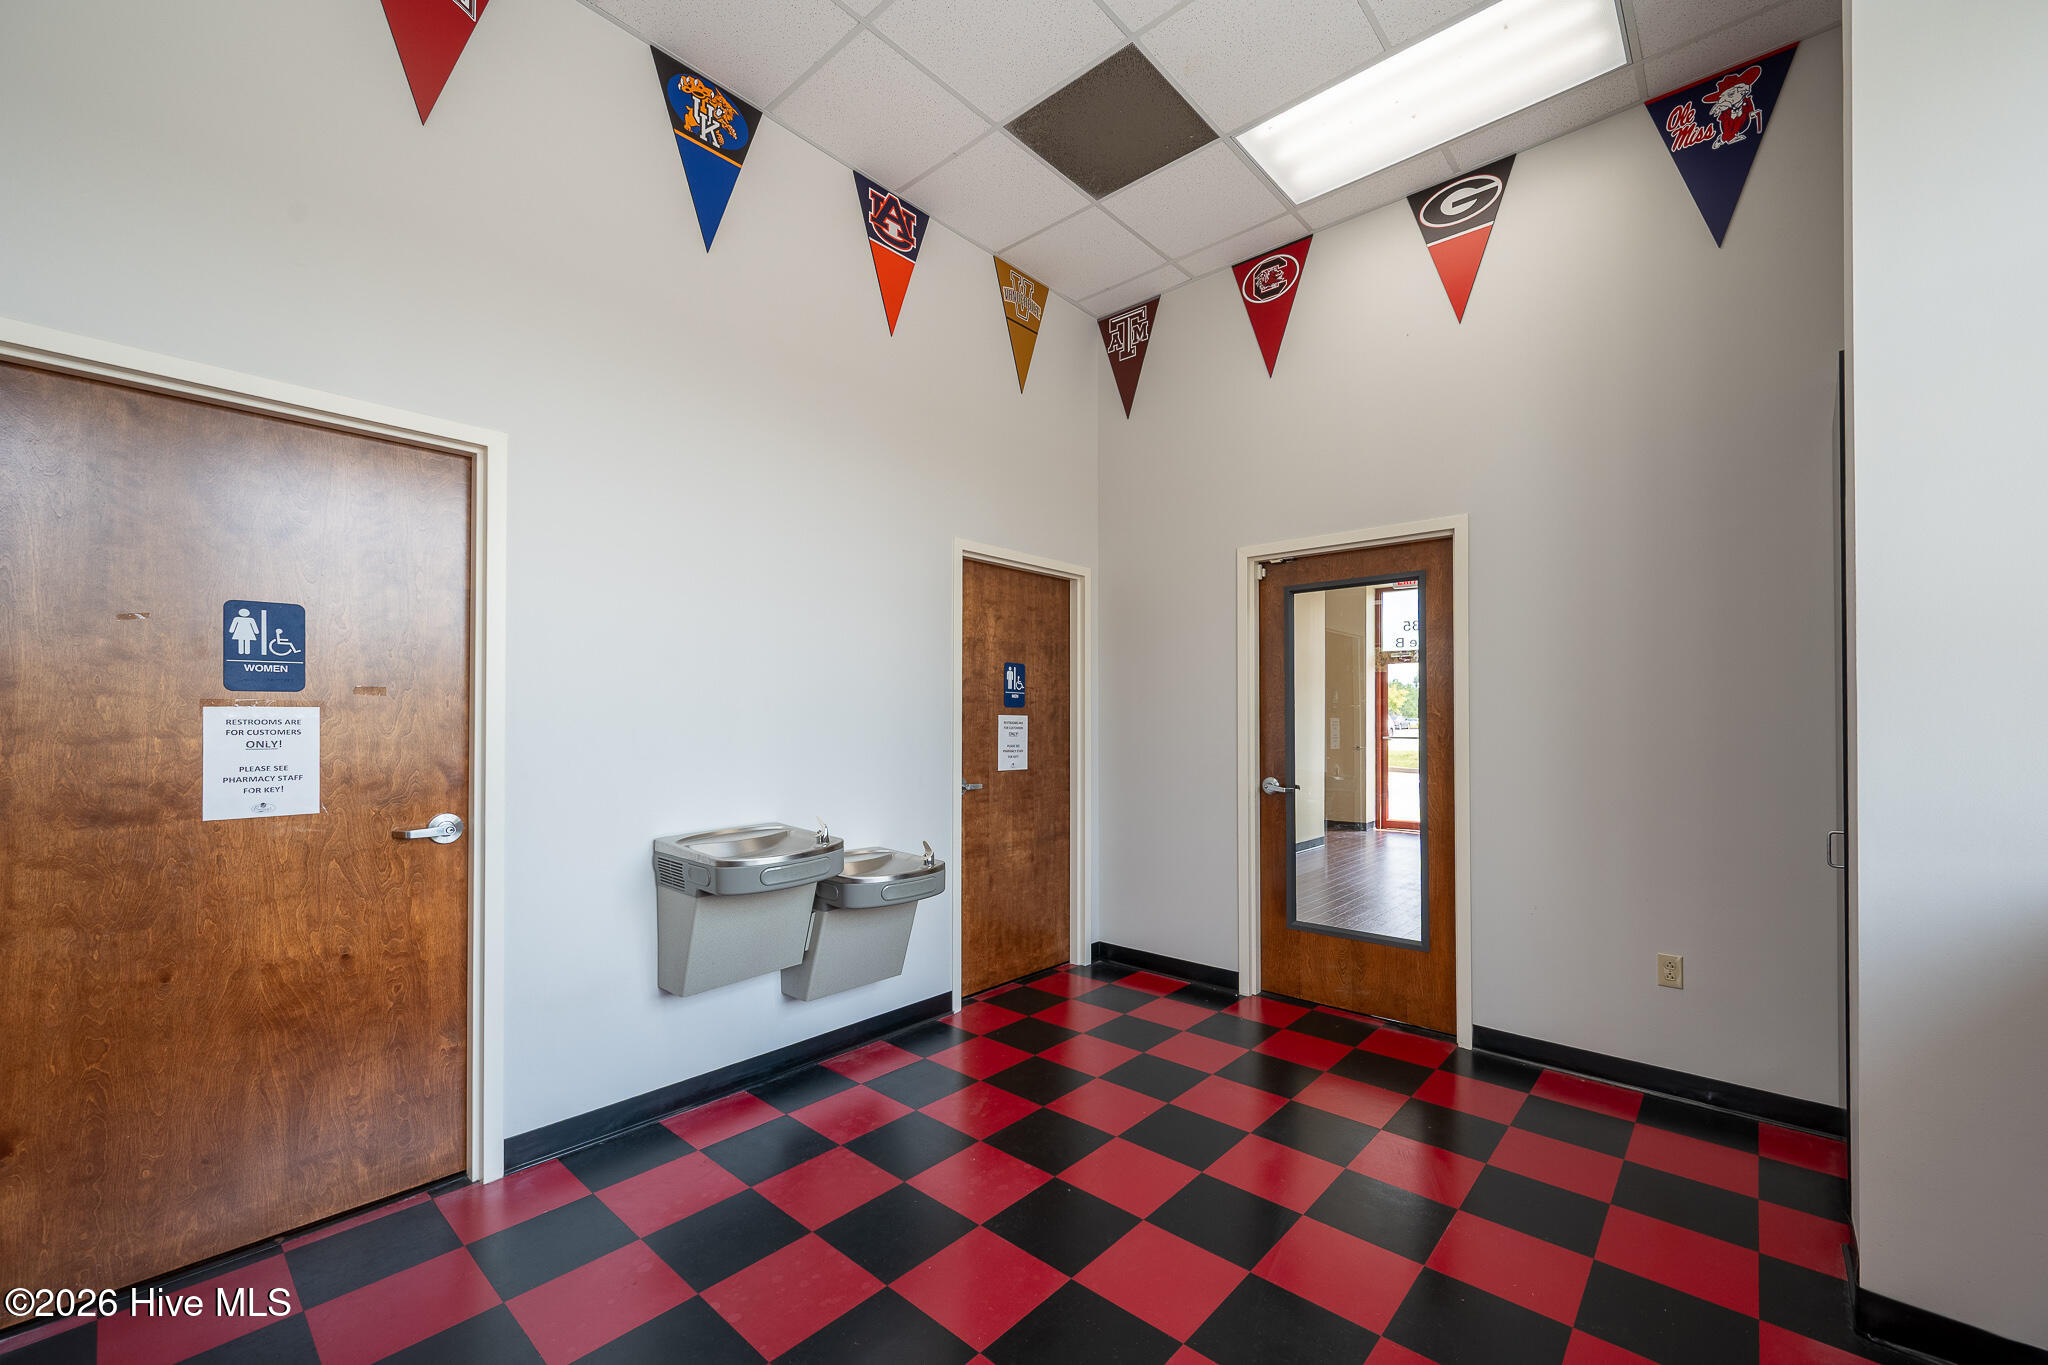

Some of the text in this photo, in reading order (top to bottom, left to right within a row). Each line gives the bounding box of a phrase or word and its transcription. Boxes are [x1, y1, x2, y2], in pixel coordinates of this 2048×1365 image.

[1666, 101, 1697, 132] Ole
[1671, 123, 1717, 152] Miss
[243, 663, 289, 673] WOMEN
[225, 718, 302, 726] RESTROOMS ARE
[245, 739, 282, 749] ONLY!
[239, 764, 289, 773] PLEASE SEE
[222, 774, 304, 784] PHARMACY STAFF
[263, 785, 284, 793] KEY!
